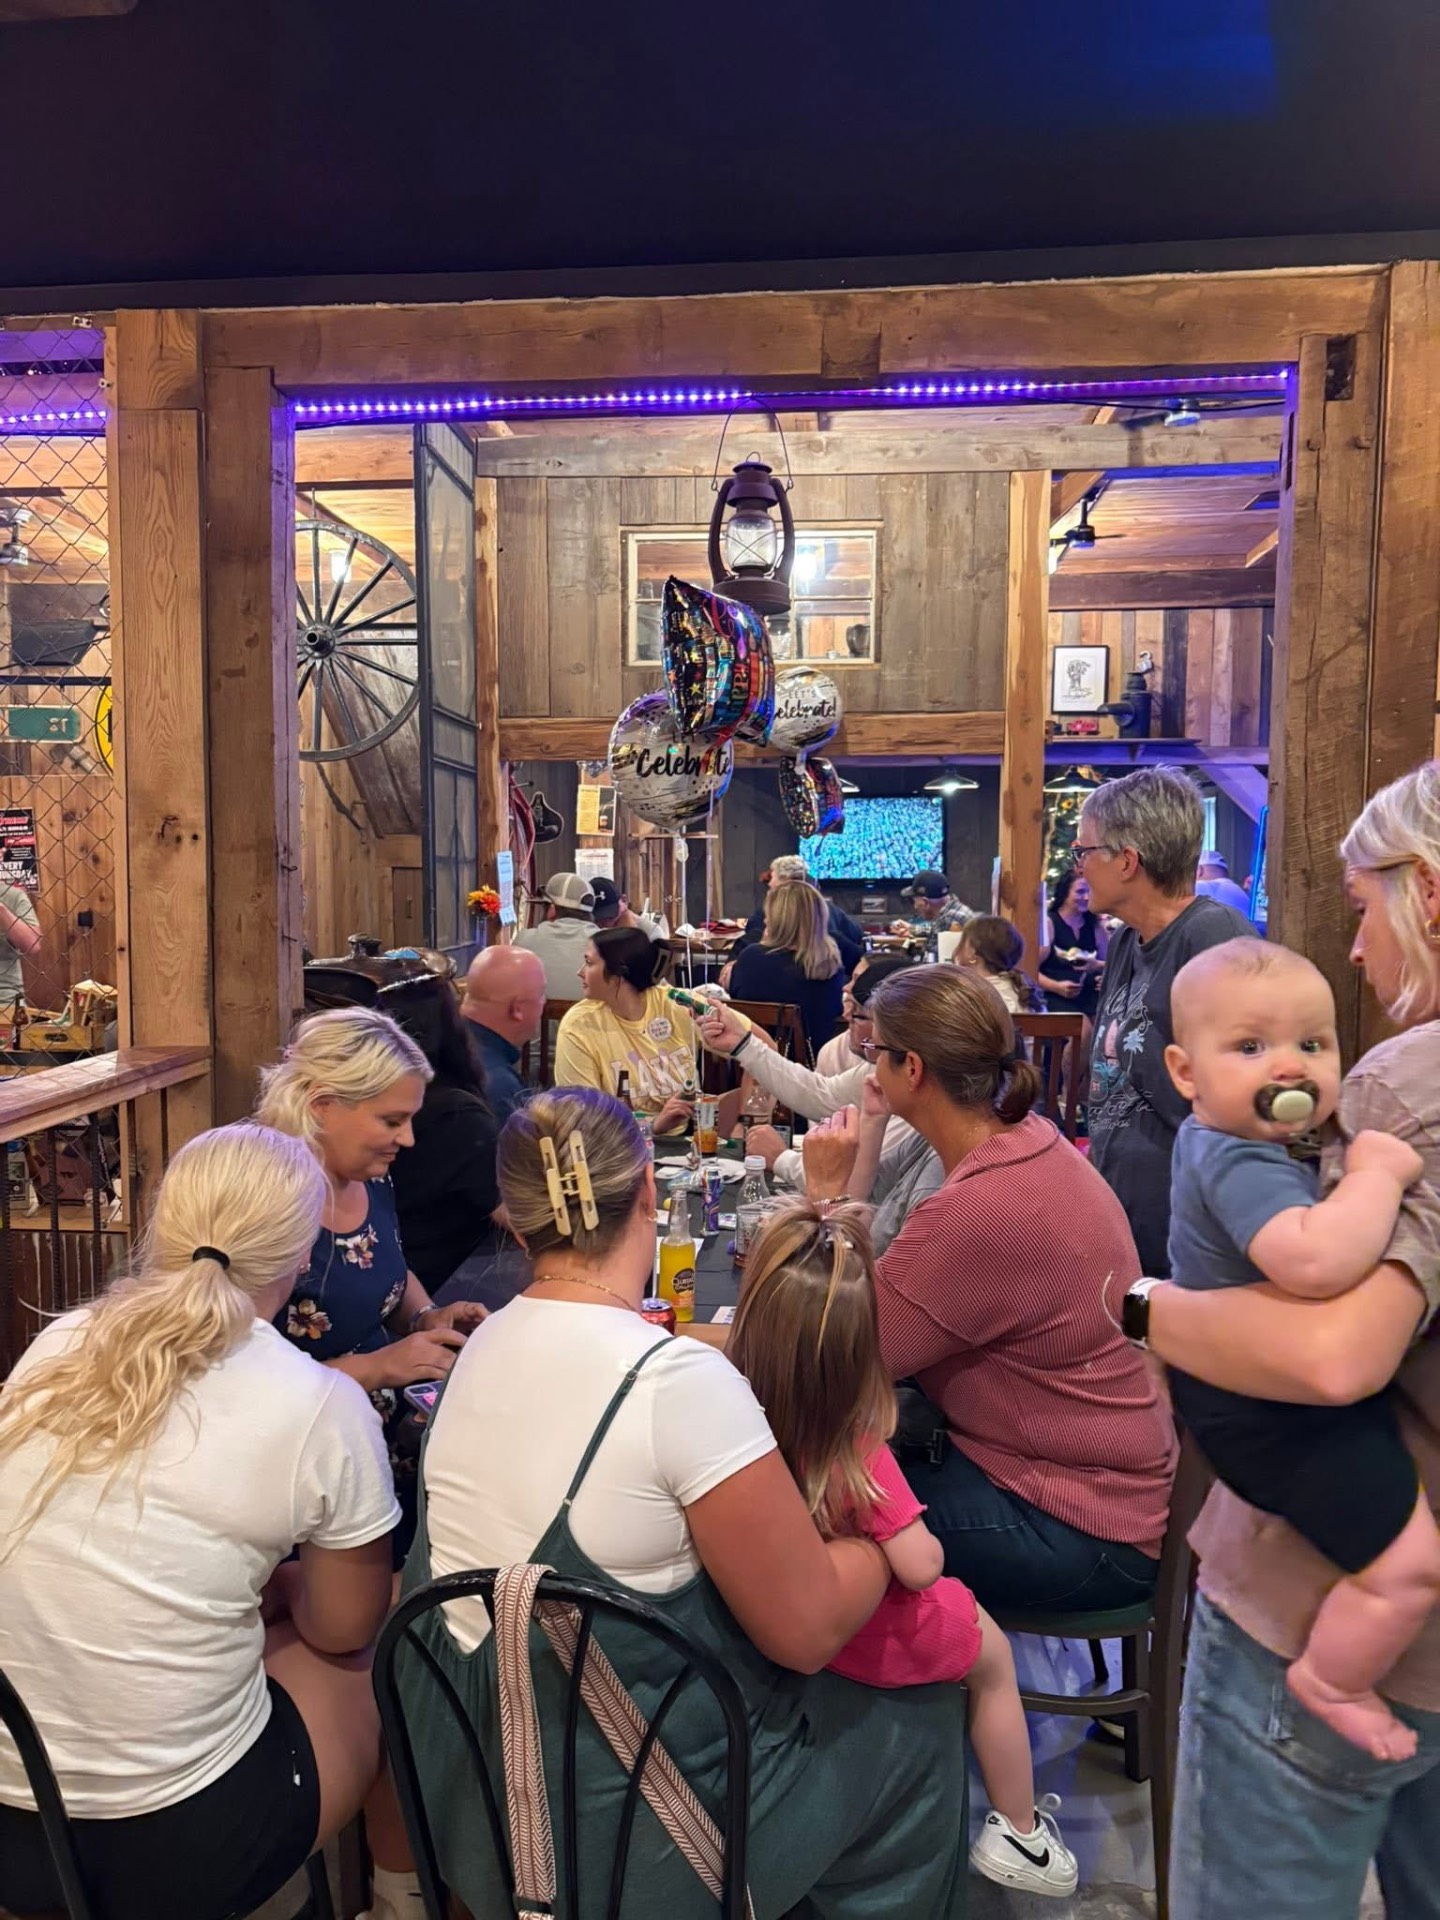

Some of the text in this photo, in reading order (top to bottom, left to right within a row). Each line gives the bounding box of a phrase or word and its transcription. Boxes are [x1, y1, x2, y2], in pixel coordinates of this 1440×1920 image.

[774, 697, 837, 720] elebrate!
[49, 717, 69, 733] ST
[636, 744, 730, 778] Celebrte
